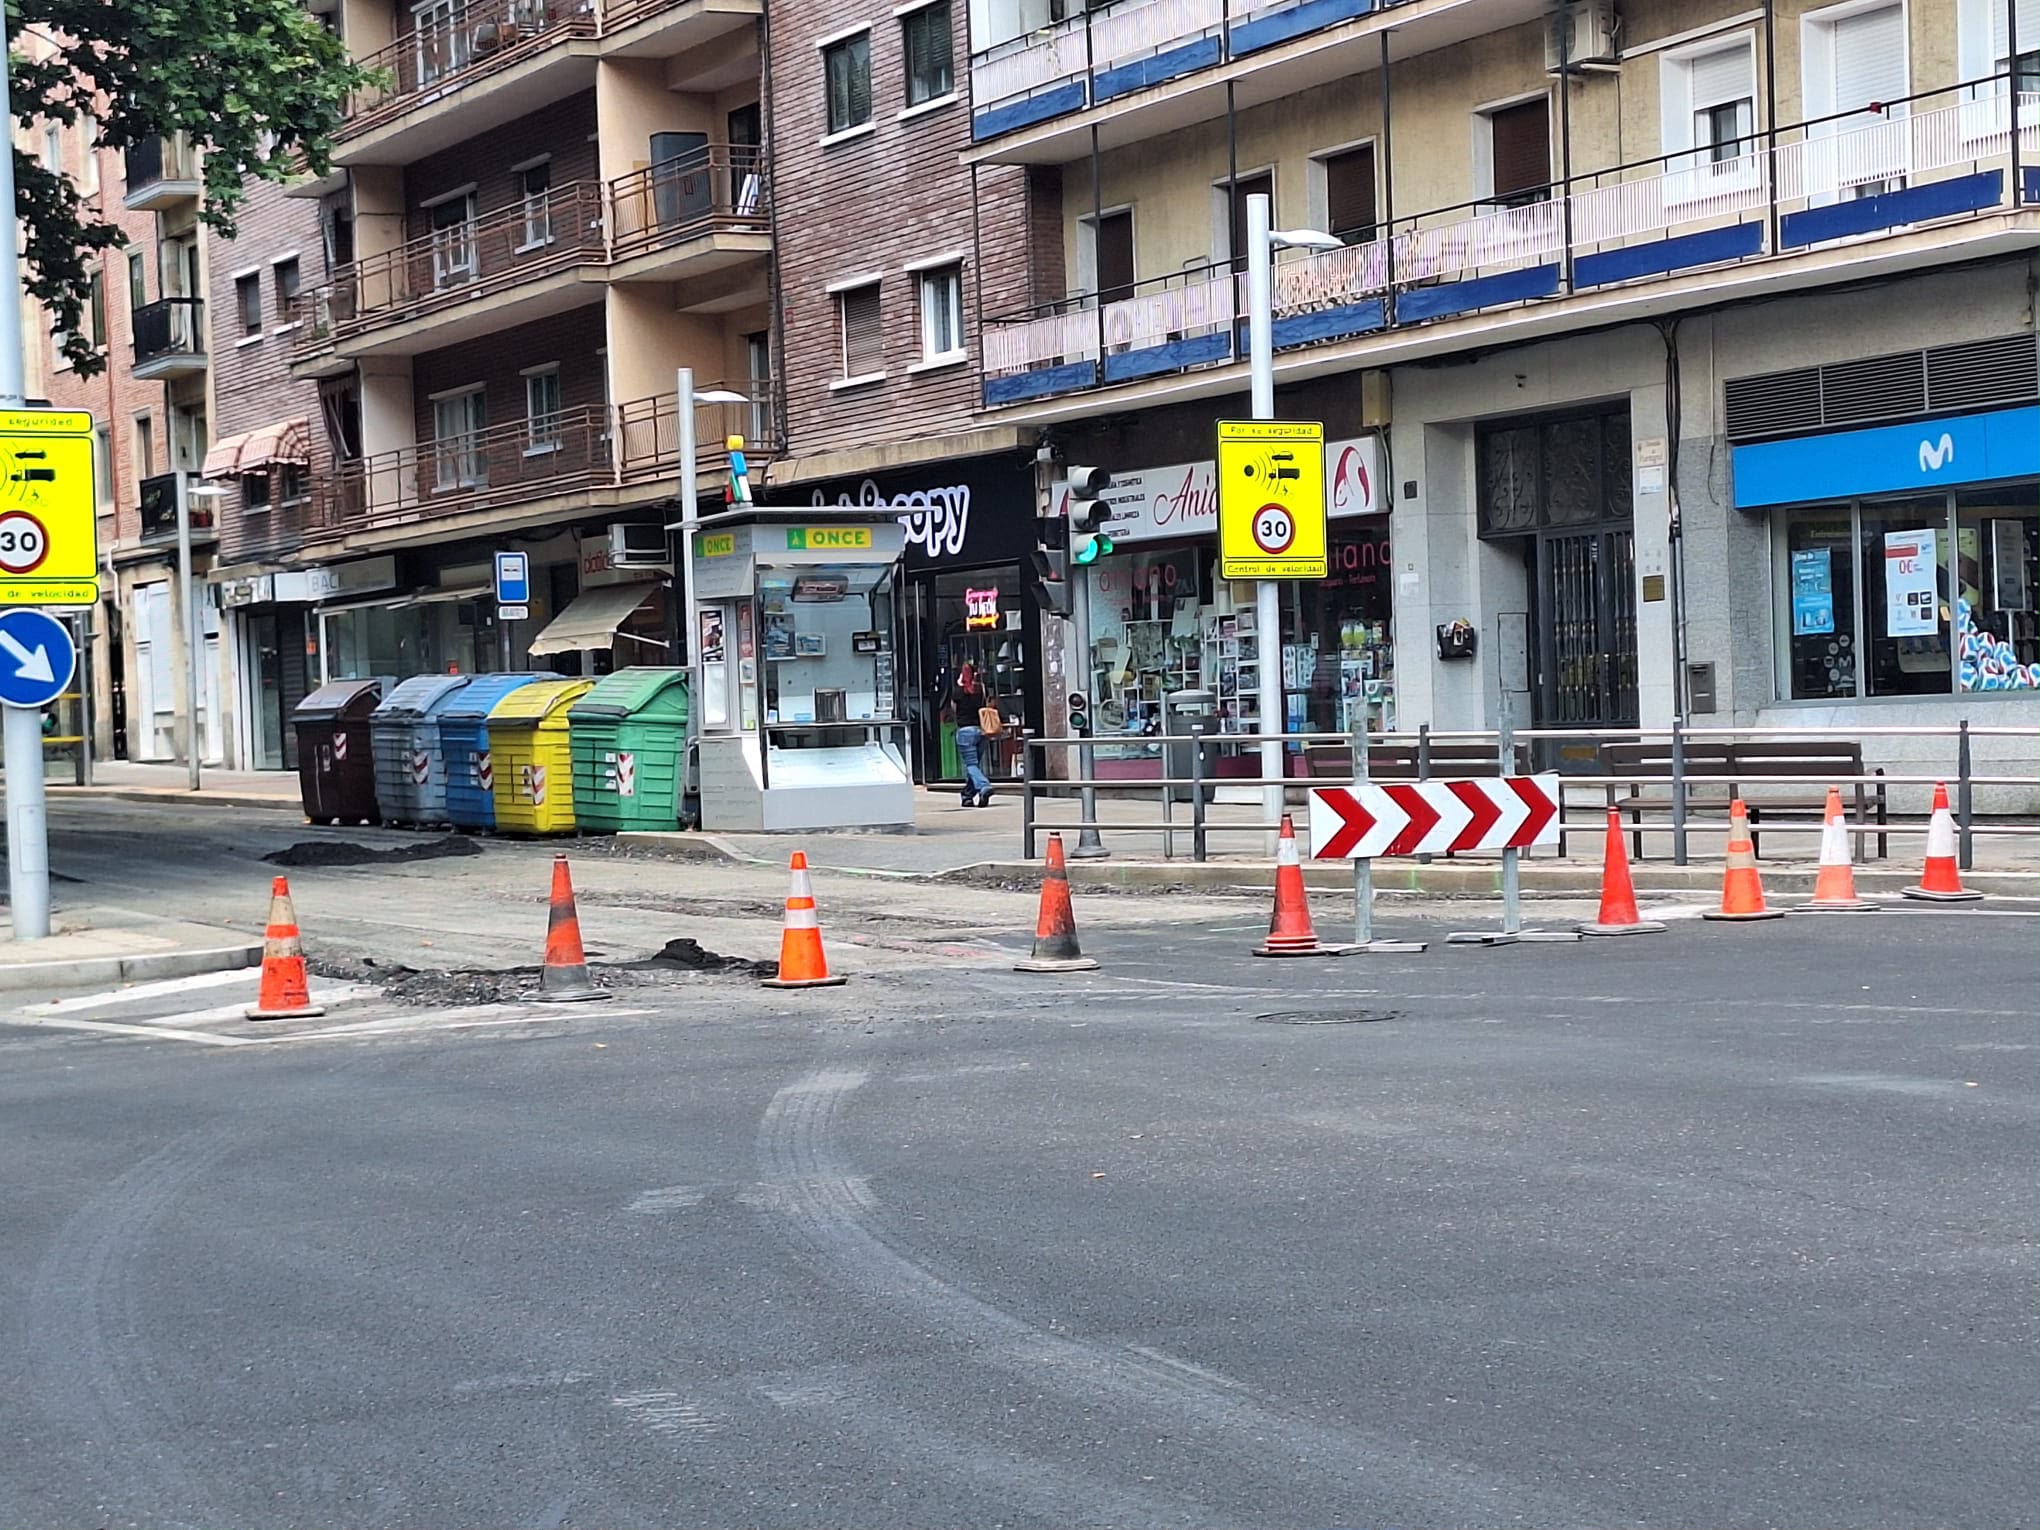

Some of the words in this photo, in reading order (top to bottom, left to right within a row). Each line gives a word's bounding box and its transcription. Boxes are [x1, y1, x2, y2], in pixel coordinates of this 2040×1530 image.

[1919, 432, 1953, 473] M
[812, 530, 865, 545] ONCE
[1261, 520, 1287, 538] 30
[0, 531, 37, 552] 30
[706, 537, 732, 553] ONCE
